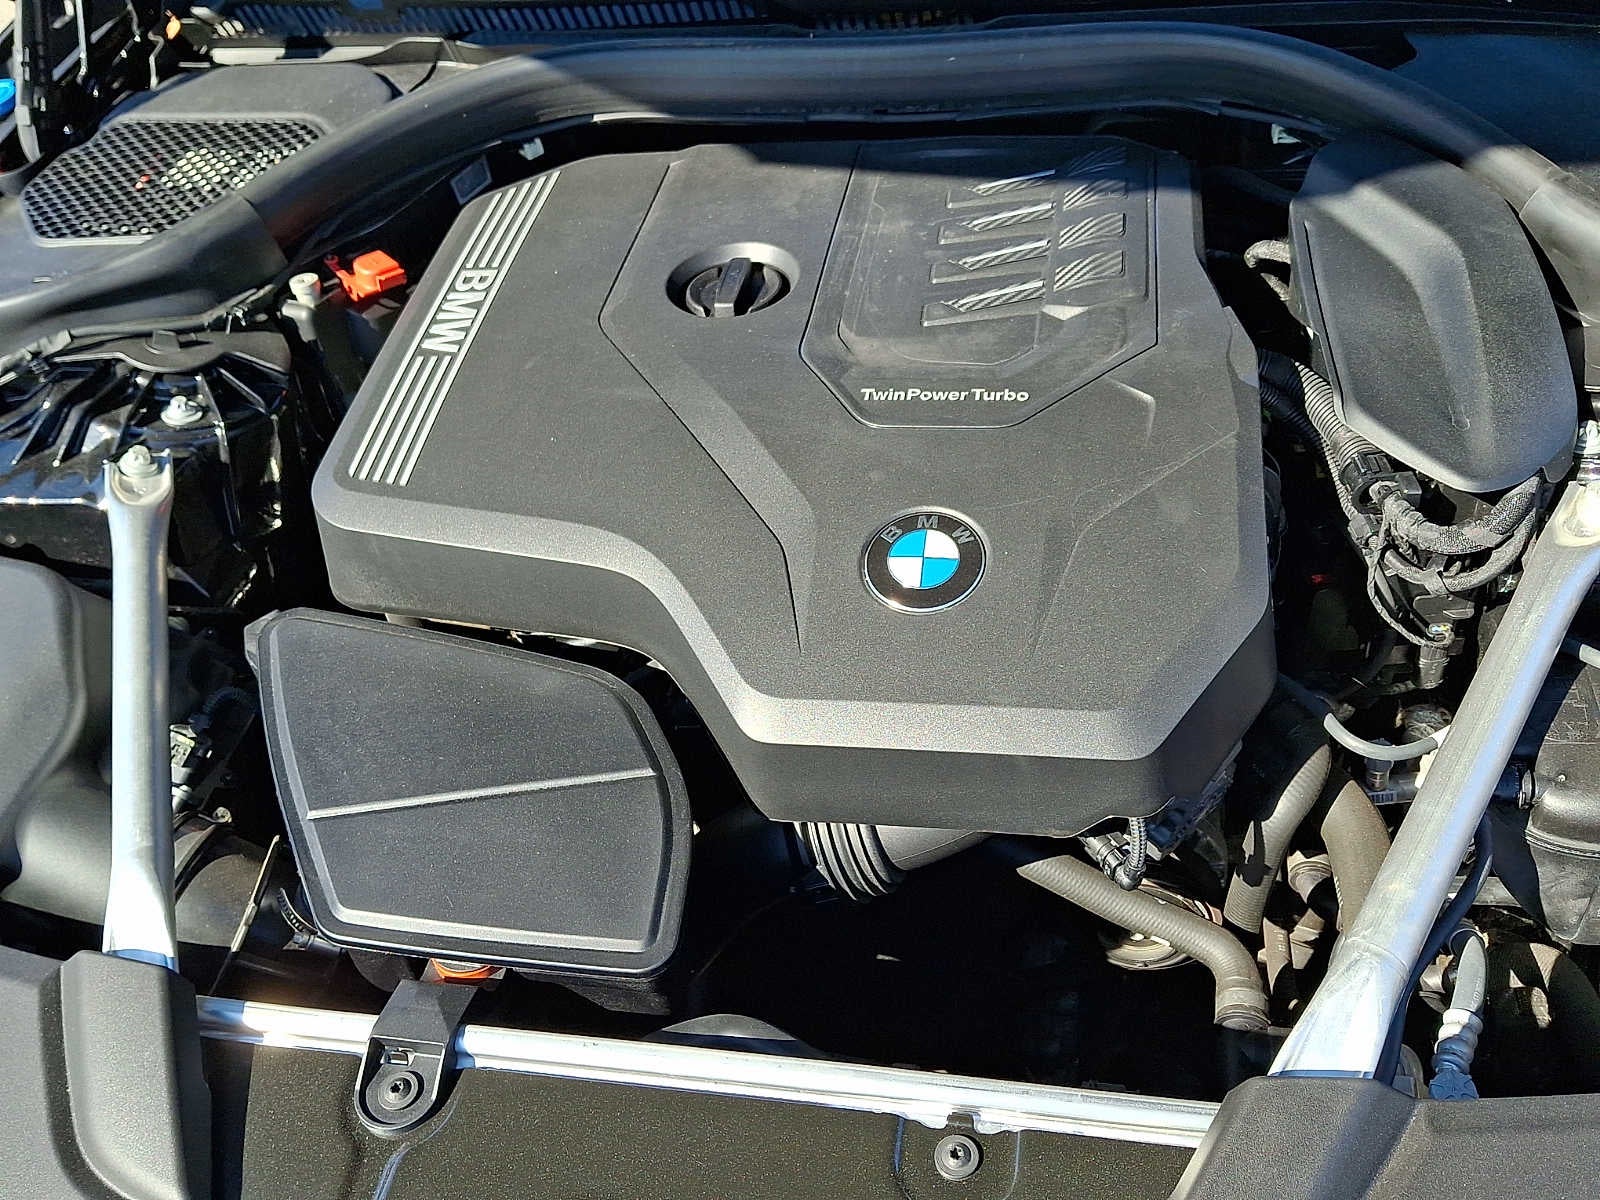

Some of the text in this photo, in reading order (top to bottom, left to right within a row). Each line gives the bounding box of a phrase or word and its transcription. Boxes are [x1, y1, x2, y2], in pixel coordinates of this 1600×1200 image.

[421, 269, 499, 353] BMW
[860, 388, 1030, 401] TwinPower Turbo
[880, 515, 976, 544] BMW
